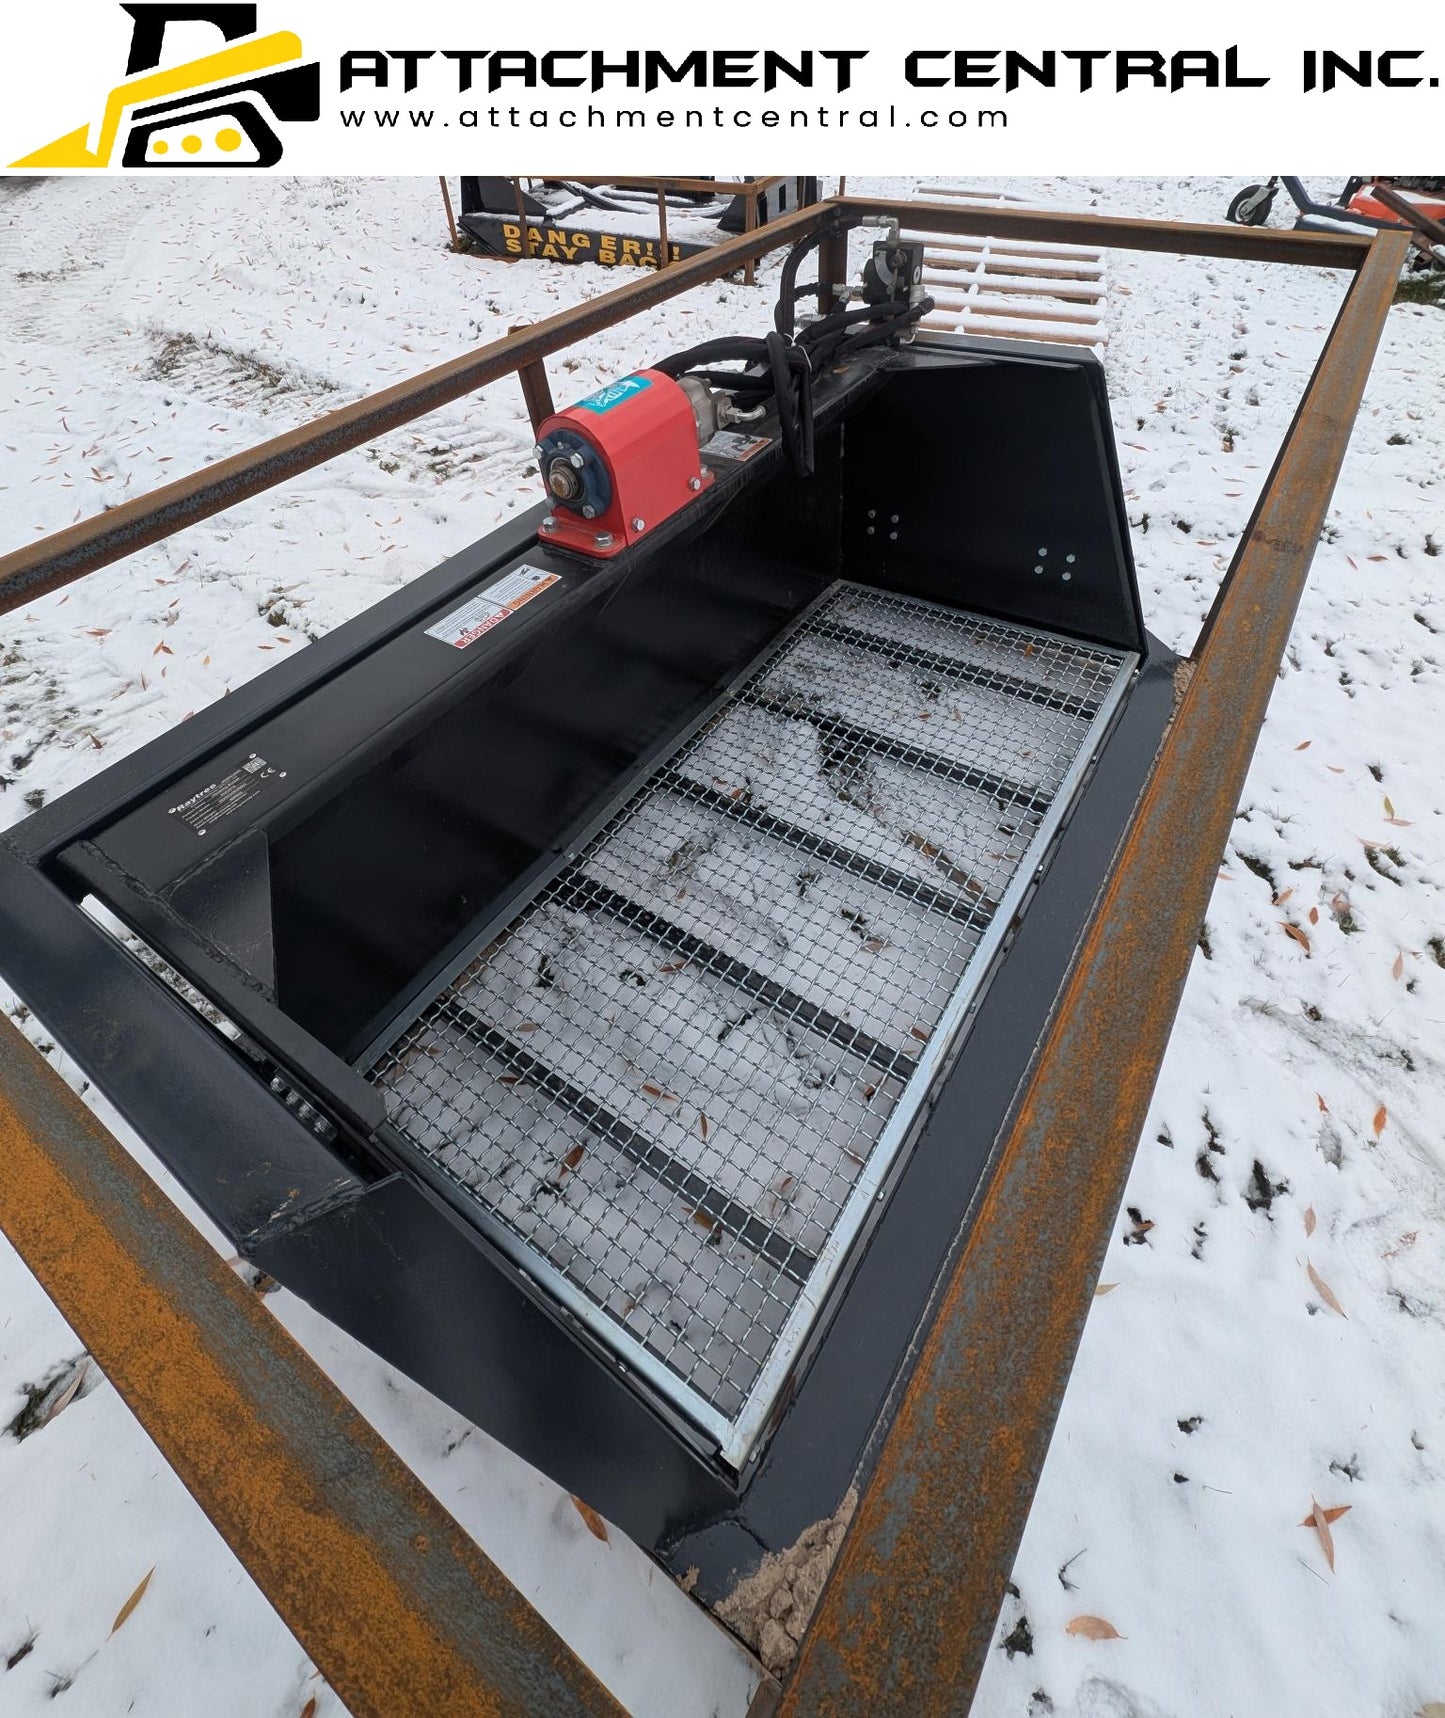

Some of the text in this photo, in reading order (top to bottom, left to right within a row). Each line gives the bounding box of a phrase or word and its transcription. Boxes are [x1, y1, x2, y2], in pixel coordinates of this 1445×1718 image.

[505, 239, 658, 269] STAY BAC
[462, 612, 501, 644] DANGER
[176, 783, 217, 812] Raytree
